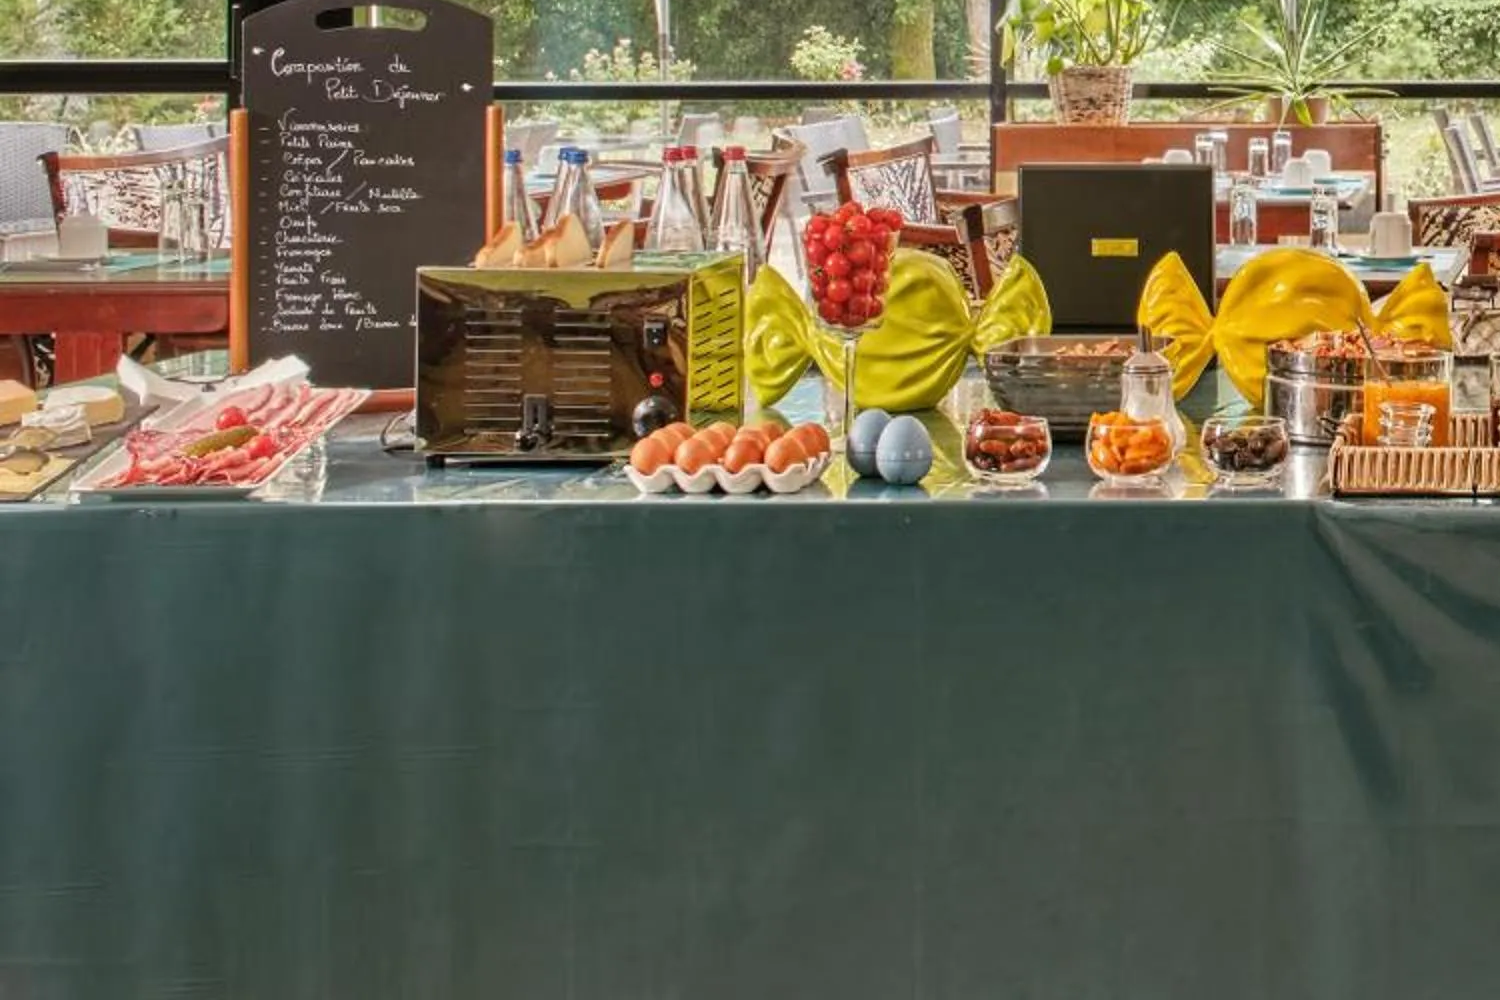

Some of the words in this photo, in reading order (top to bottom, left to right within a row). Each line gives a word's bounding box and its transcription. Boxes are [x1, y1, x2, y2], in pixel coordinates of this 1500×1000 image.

[387, 53, 412, 73] du
[325, 77, 359, 100] Petit
[279, 131, 310, 148] Petits
[318, 133, 353, 148] Pains
[353, 149, 415, 167] Pancakes
[278, 198, 309, 213] Miel
